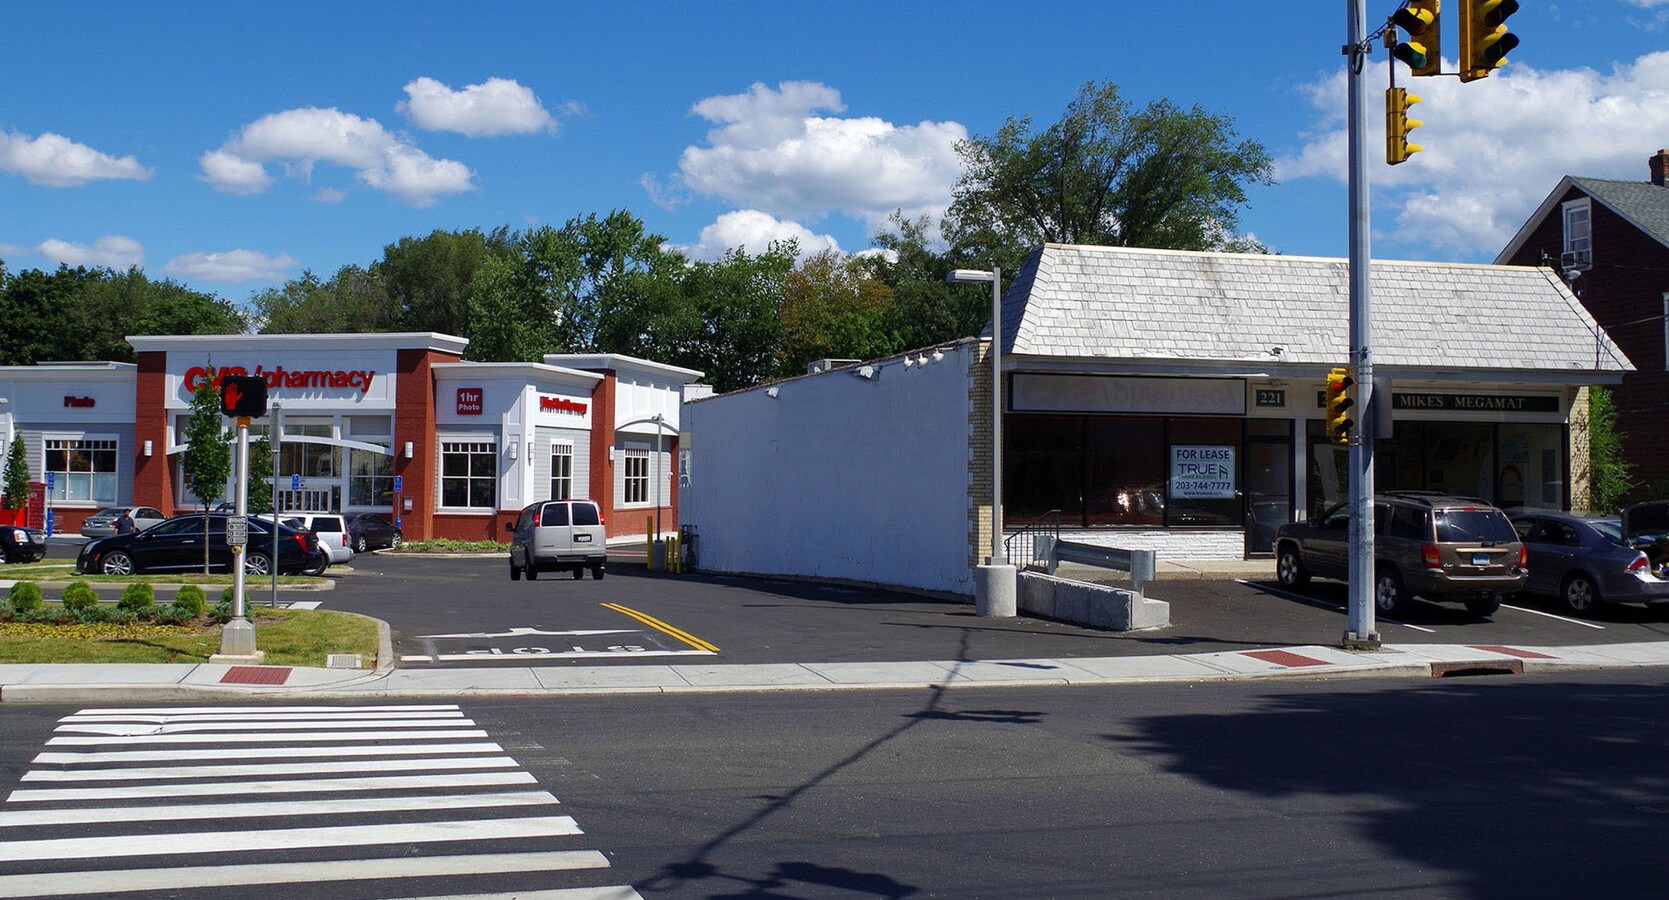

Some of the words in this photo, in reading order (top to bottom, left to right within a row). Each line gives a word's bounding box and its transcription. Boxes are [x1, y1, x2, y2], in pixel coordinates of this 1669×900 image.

[460, 392, 479, 402] 1hr
[1260, 392, 1280, 404] 221
[1400, 395, 1444, 408] MIKE'S
[1454, 396, 1526, 410] MEGAMAT
[1176, 449, 1197, 459] FOR
[1200, 449, 1230, 459] LEASE
[1177, 463, 1218, 474] TRUE
